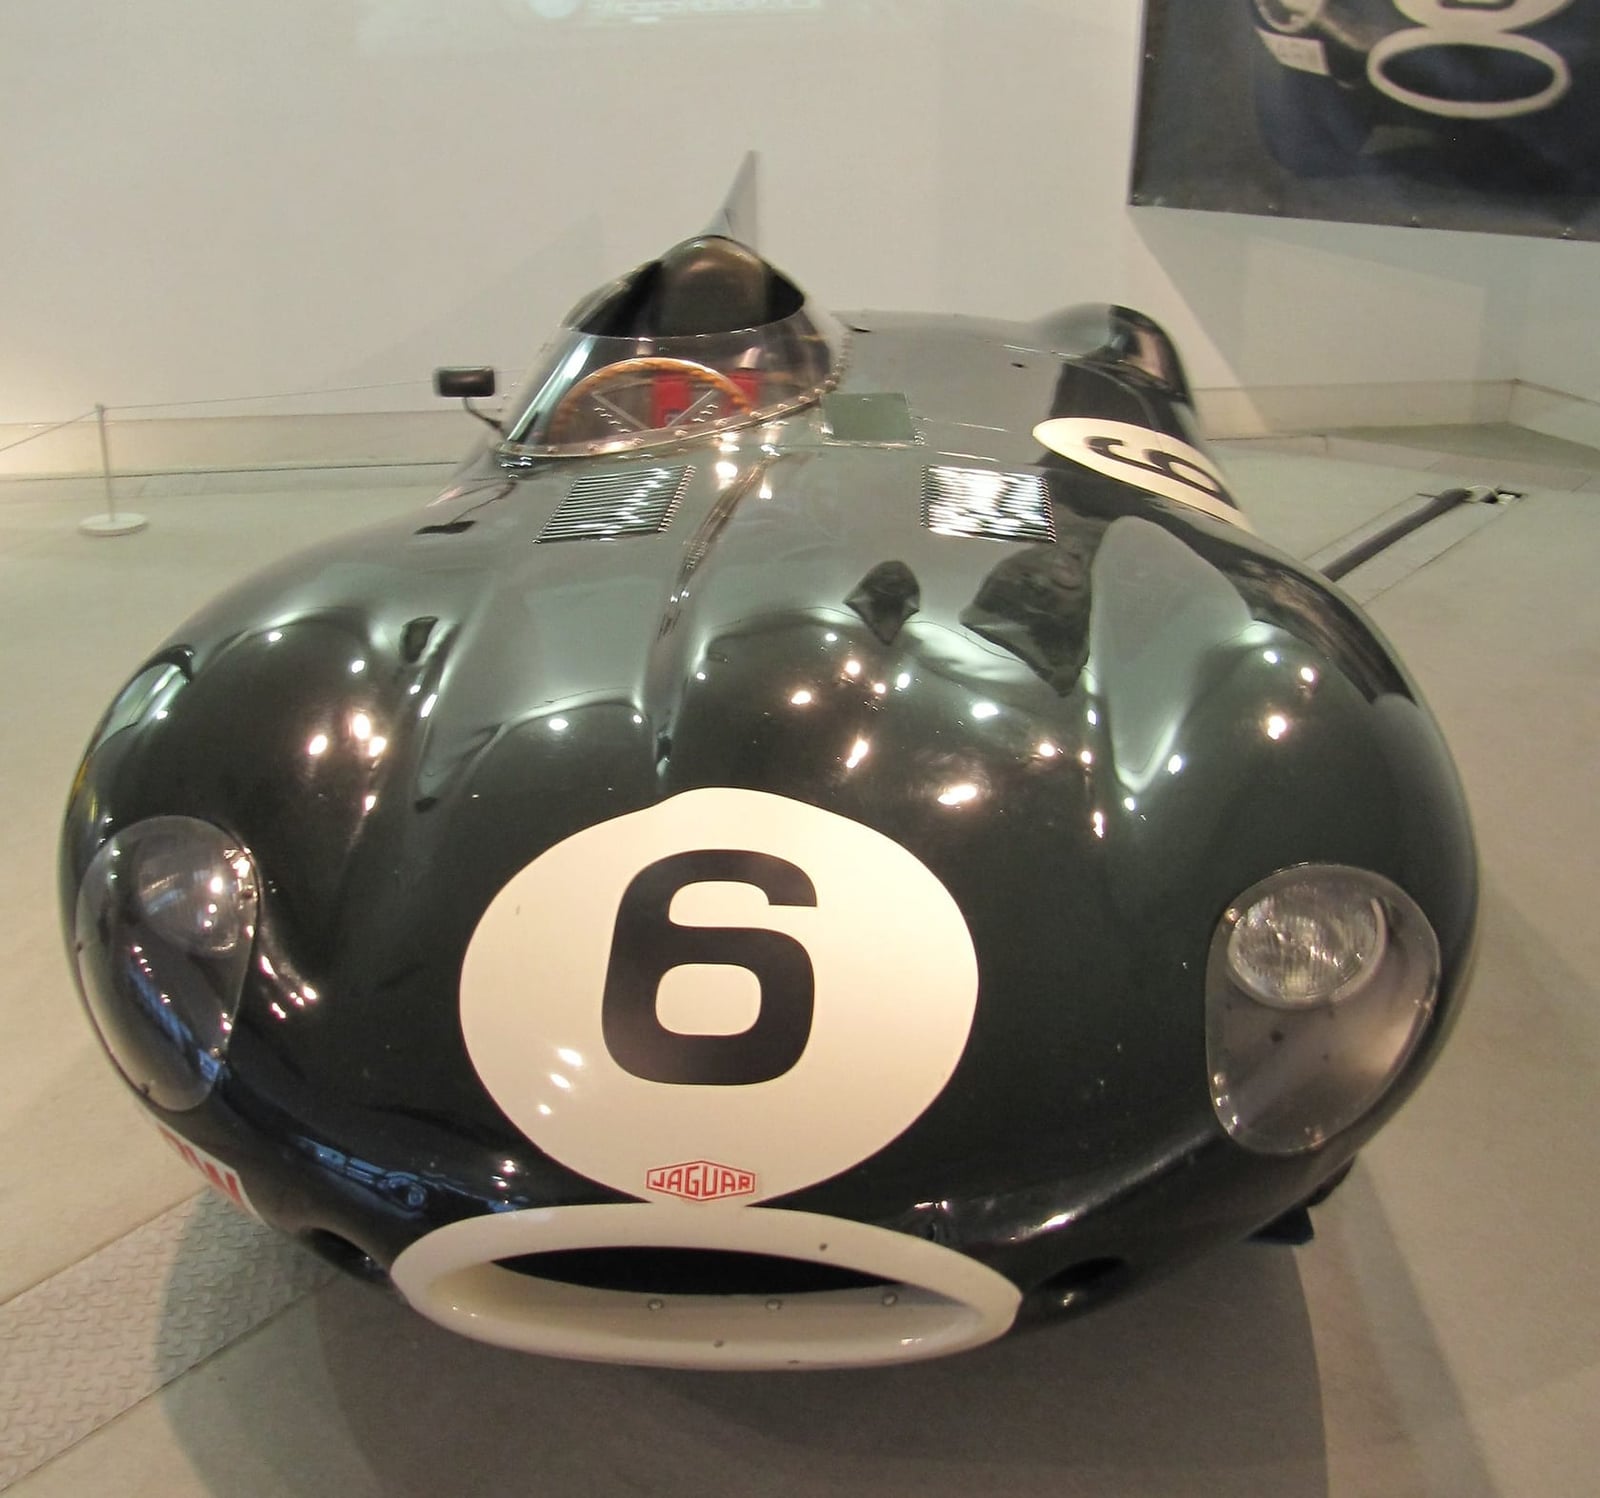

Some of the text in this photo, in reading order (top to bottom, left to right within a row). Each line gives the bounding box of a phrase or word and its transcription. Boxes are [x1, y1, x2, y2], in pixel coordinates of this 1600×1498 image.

[1085, 436, 1239, 510] 6
[602, 849, 817, 1085] 6
[651, 1165, 751, 1197] JAGUAR
